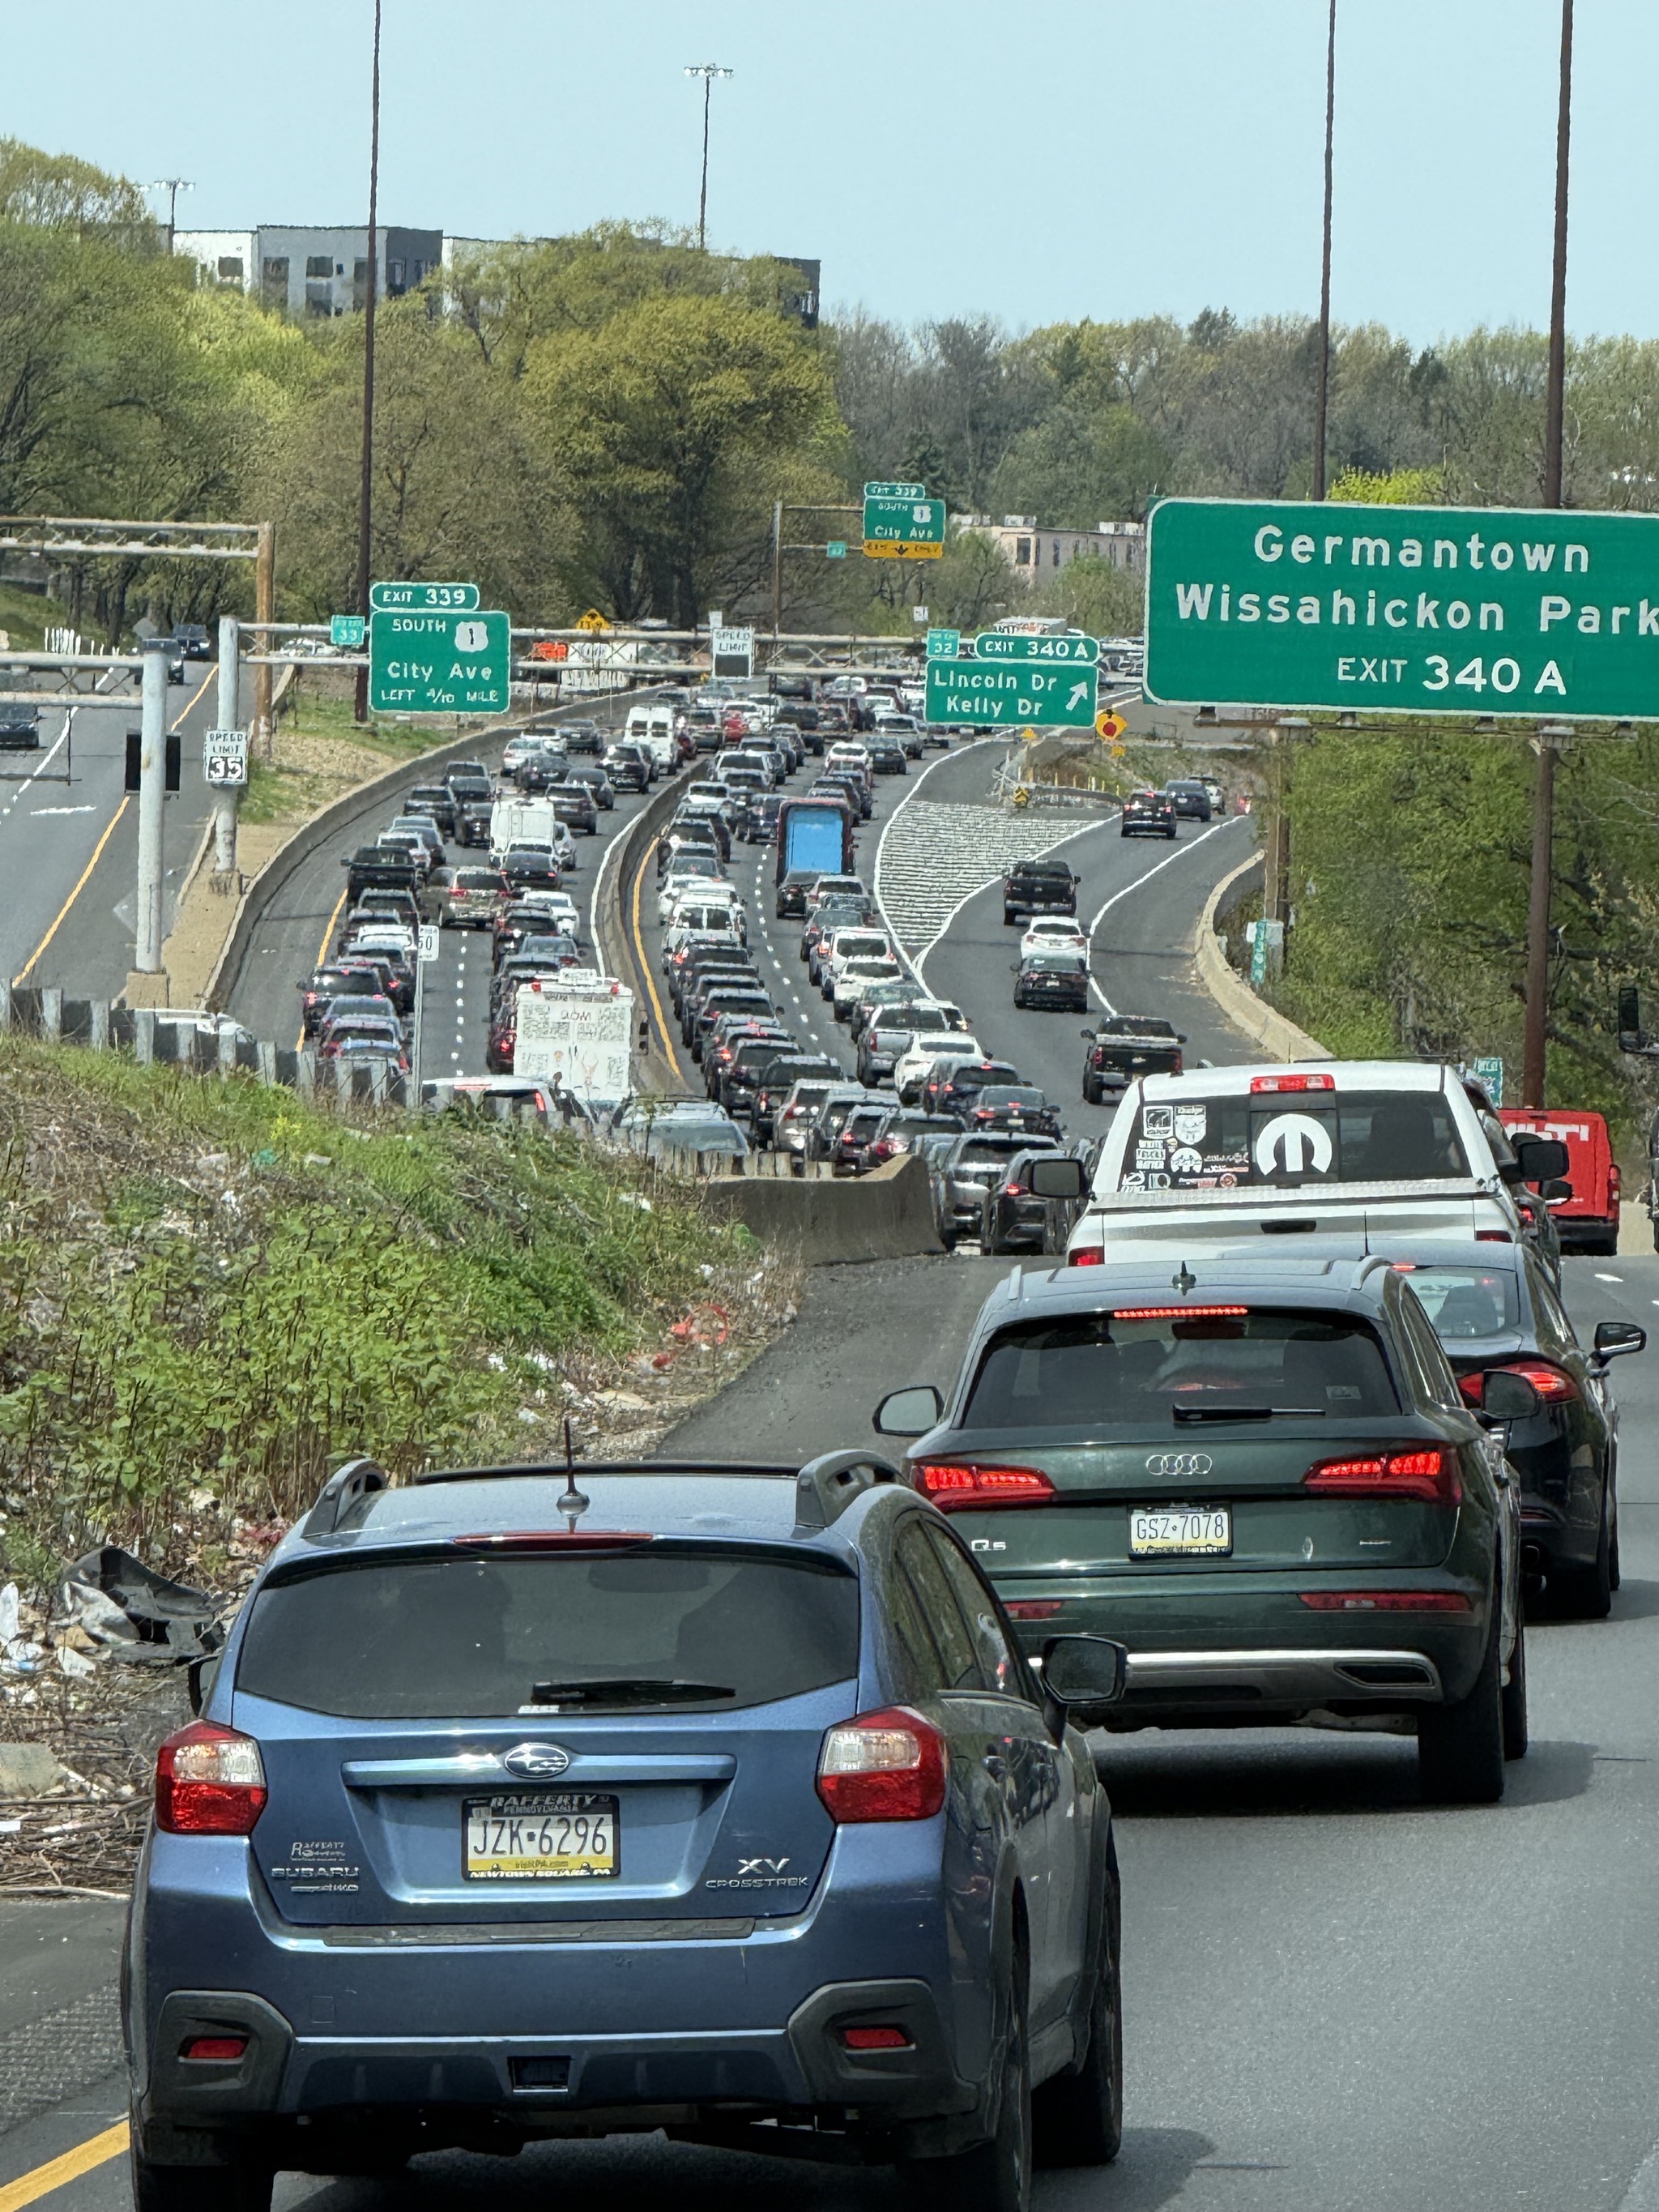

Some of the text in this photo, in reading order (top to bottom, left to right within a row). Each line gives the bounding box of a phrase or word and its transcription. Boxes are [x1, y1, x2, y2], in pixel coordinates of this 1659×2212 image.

[1254, 524, 1589, 573] Germantown
[382, 588, 466, 606] EXIT 339
[1175, 583, 1659, 636] Wissahickon Park
[391, 618, 447, 634] SOUTH
[468, 628, 475, 646] 1
[985, 640, 1089, 659] EXIT 340 A
[387, 661, 493, 682] City Ave
[934, 669, 1057, 691] Lincoln Dr
[1337, 655, 1567, 695] EXIT 340 A
[381, 690, 416, 702] LEFT
[466, 690, 499, 703] MILE
[946, 694, 1043, 719] Kelly Dr
[210, 757, 242, 779] 35
[490, 1795, 597, 1808] RAFFERTY
[271, 1867, 360, 1877] SUBARU
[737, 1857, 791, 1875] XV
[705, 1877, 808, 1889] CROSSTREK
